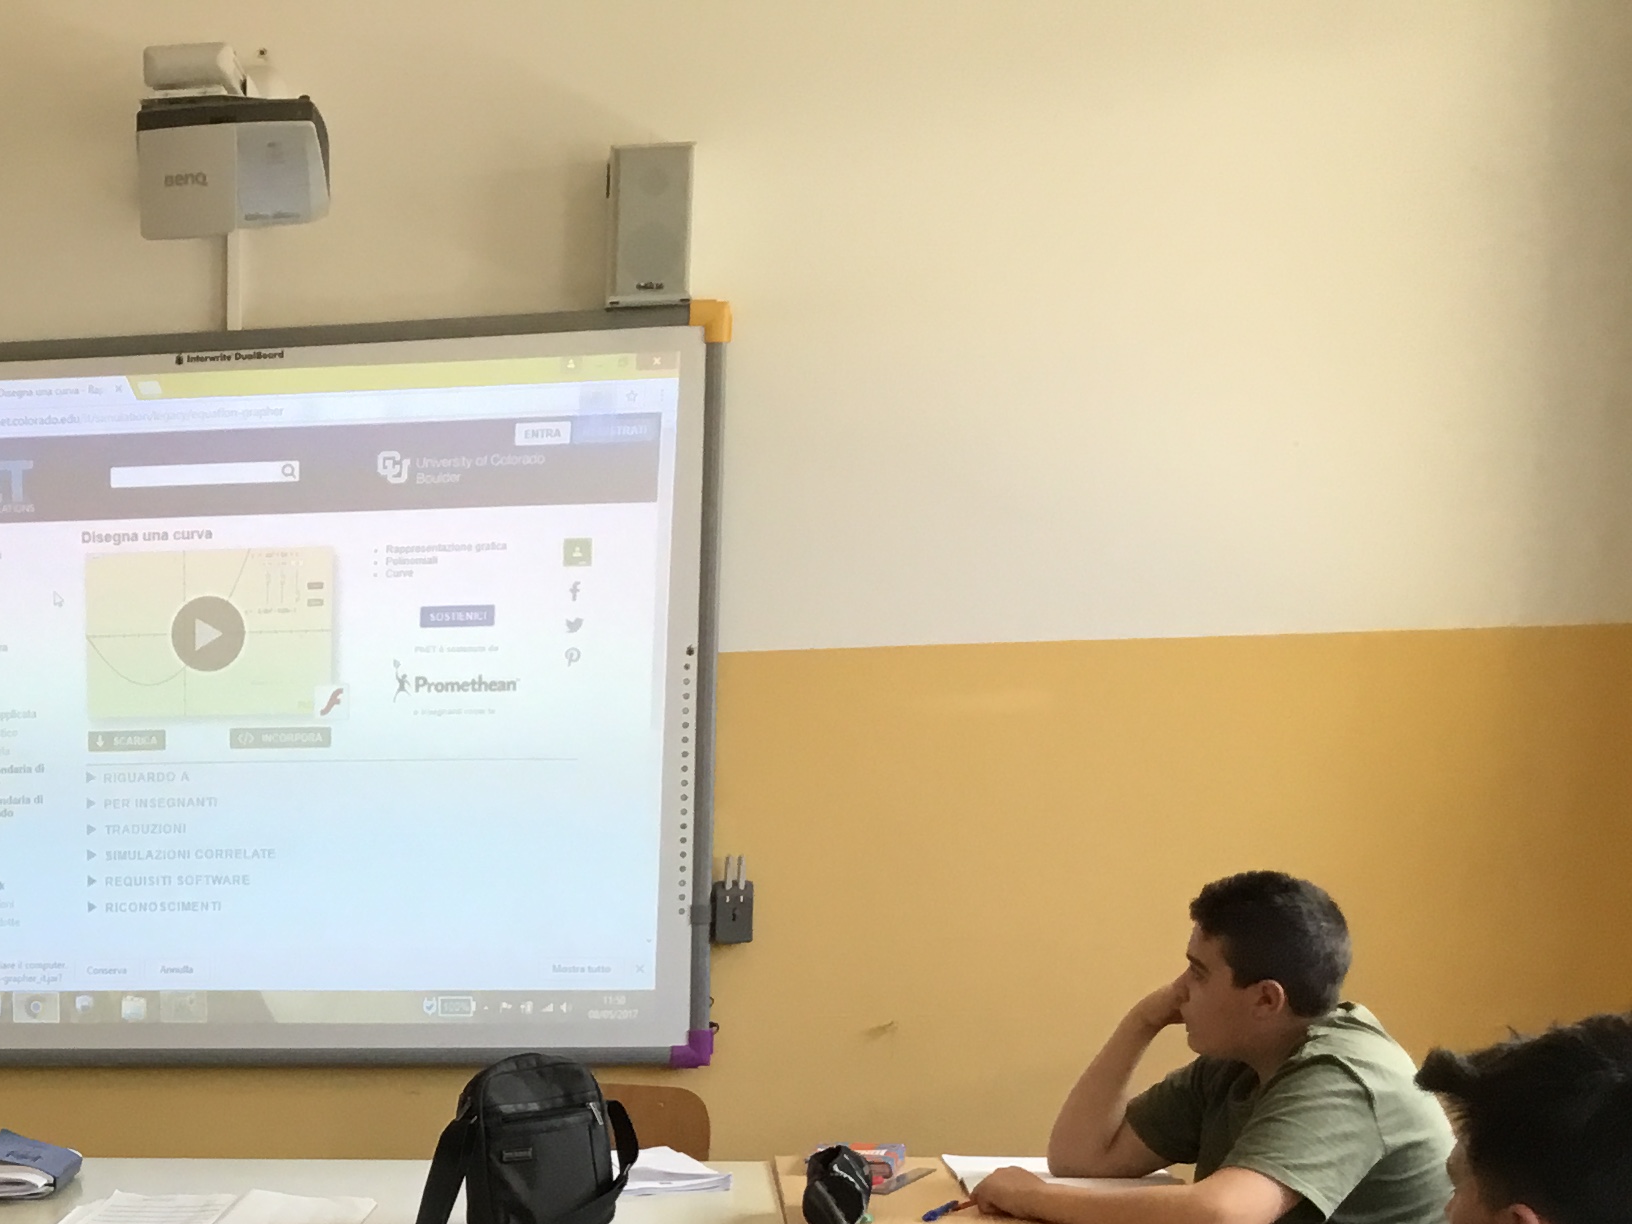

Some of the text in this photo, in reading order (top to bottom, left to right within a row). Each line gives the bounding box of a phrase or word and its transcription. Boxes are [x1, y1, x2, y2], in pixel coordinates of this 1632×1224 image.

[187, 350, 284, 363] Interwrite DualBoard
[35, 388, 52, 396] una
[524, 428, 561, 440] ENTRA
[416, 453, 545, 471] University of Colorado
[416, 472, 462, 485] Boulder
[81, 528, 213, 546] Disegna una curva
[386, 541, 507, 555] Rappresentazione grafica
[386, 556, 438, 567] Polinomiali
[386, 569, 414, 579] Curve
[414, 673, 517, 693] Promethean
[35, 763, 45, 774] di
[103, 771, 190, 784] RIGUARDO A
[33, 794, 44, 805] di
[103, 796, 218, 809] PER INSEGNANTI
[104, 823, 187, 835] TRADUZIONI
[105, 848, 277, 861] SIMULAZIONI CORRELATE
[105, 874, 250, 887] REQUISITI SOFTWARE
[105, 901, 222, 913] RICONOSCIMENTI
[86, 965, 128, 976] Conserva
[587, 963, 611, 974] tutto
